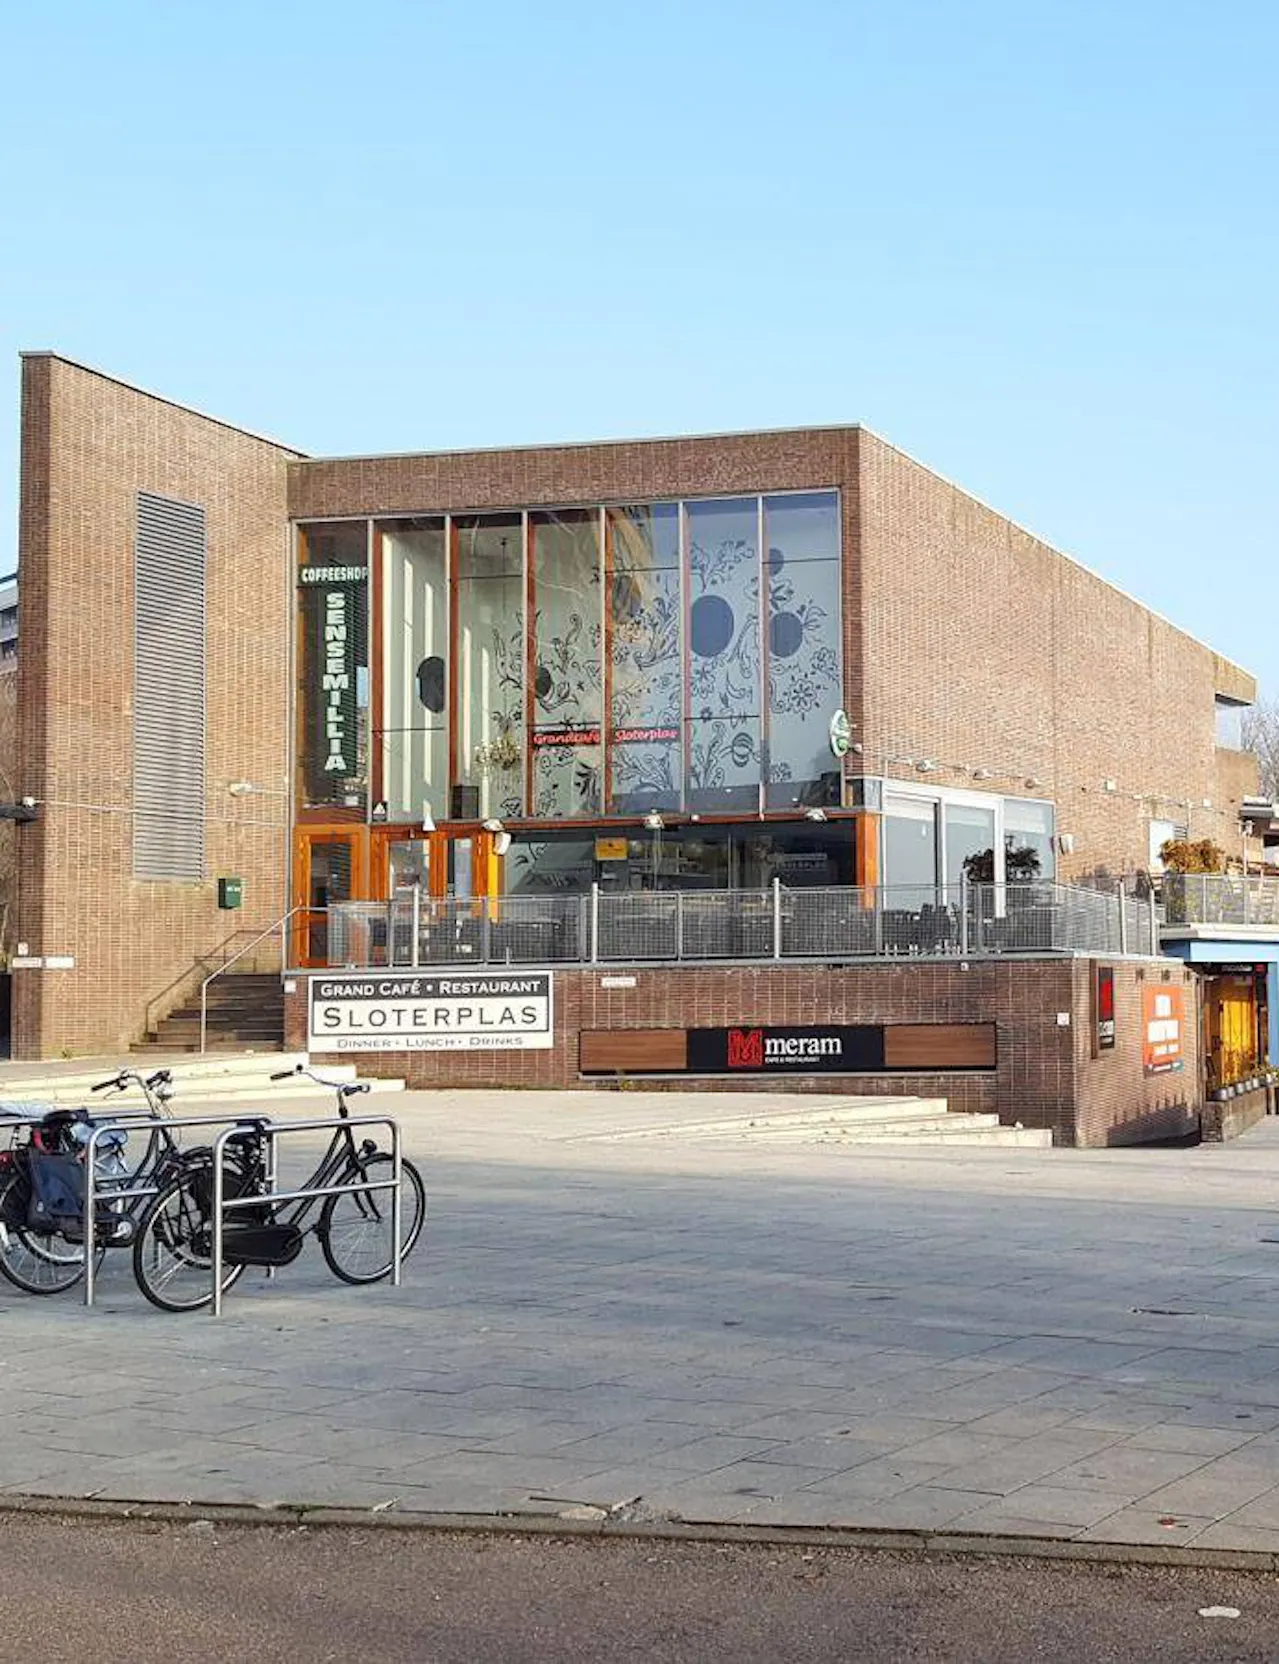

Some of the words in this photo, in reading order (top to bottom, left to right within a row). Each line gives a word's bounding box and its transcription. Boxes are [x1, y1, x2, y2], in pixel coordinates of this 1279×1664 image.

[322, 592, 349, 771] SENSEMILLIA
[320, 983, 375, 997] GRAND
[379, 979, 420, 996] CAFÉ
[439, 980, 541, 994] RESTAURANT
[323, 1006, 538, 1028] SLOTERPLAS
[336, 1038, 391, 1049] DINNER
[406, 1037, 455, 1048] LUNCH
[469, 1036, 524, 1046] DRINKS
[764, 1036, 843, 1055] meram
